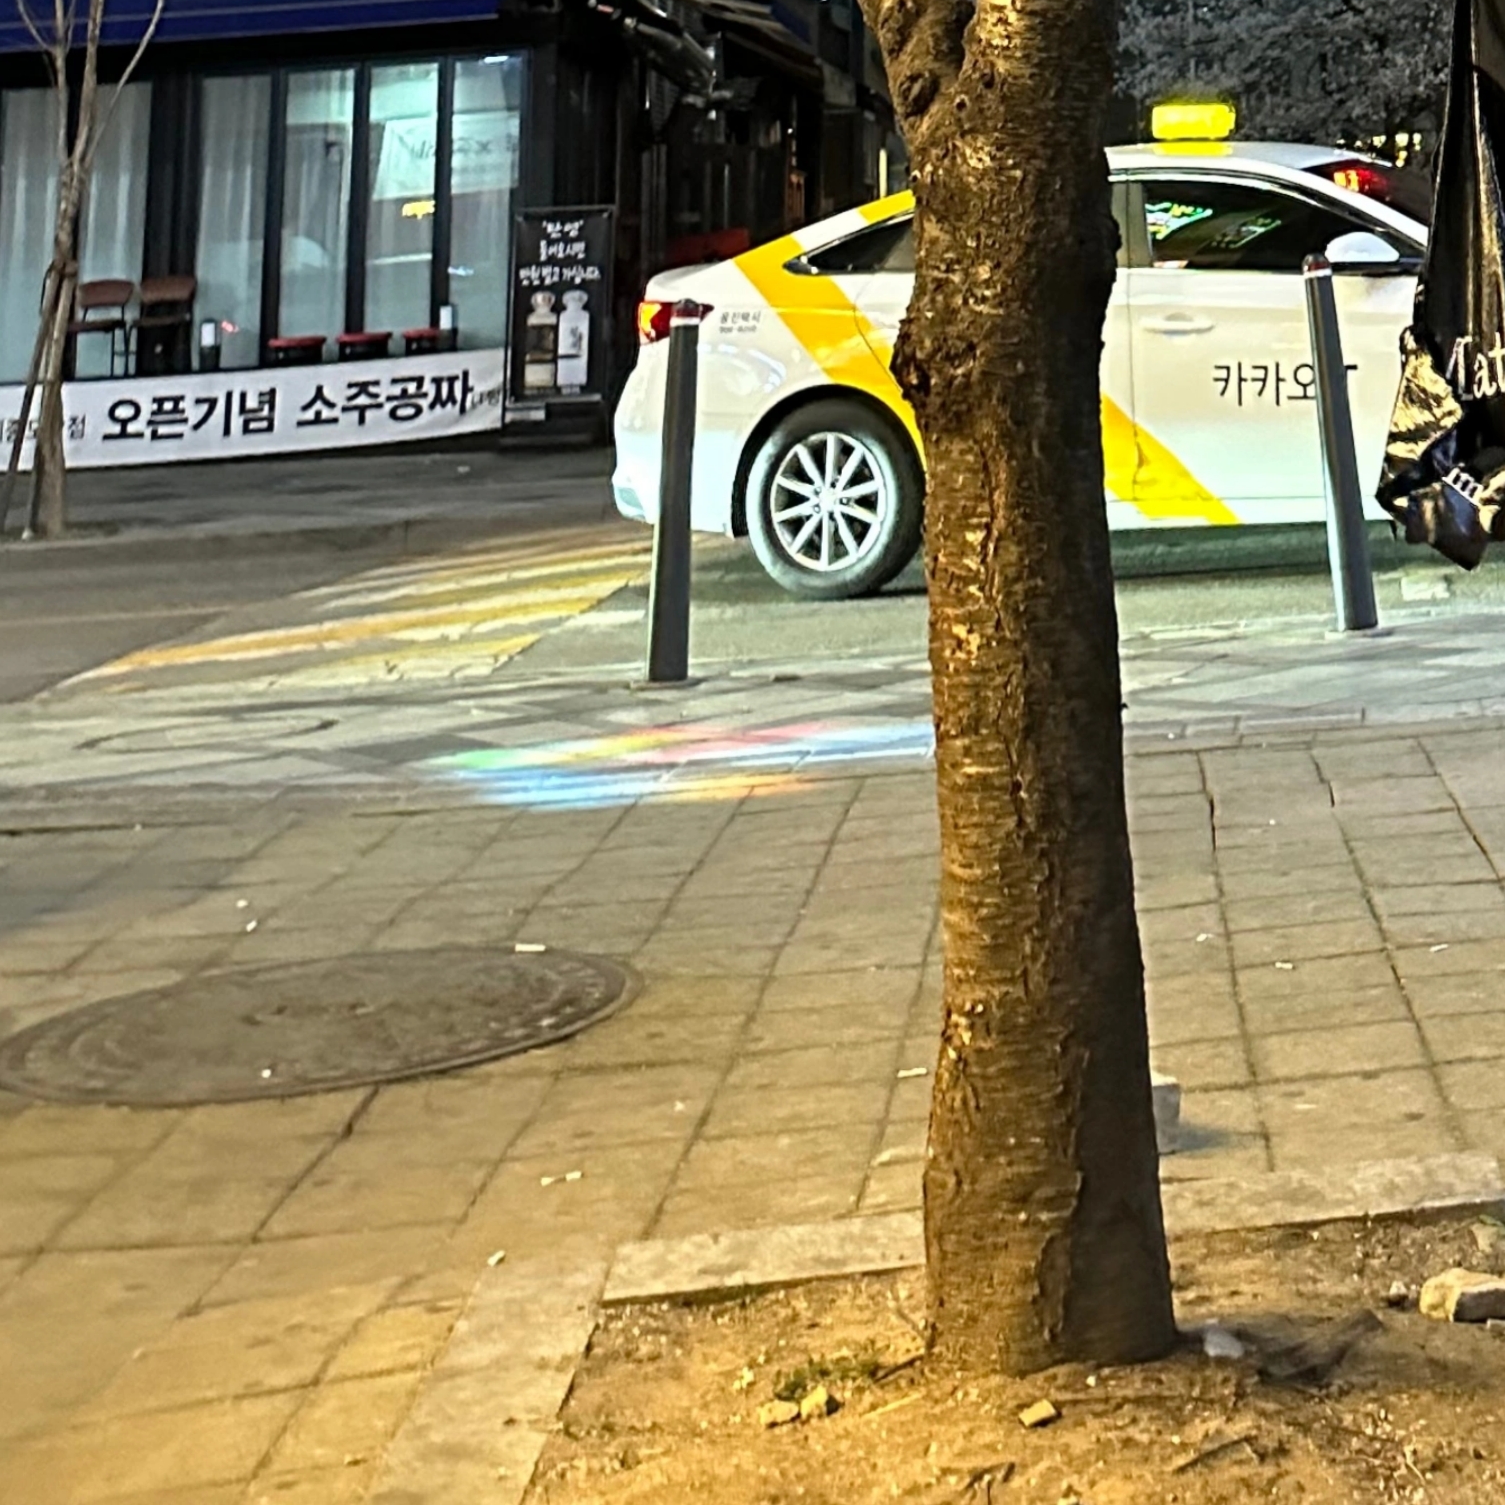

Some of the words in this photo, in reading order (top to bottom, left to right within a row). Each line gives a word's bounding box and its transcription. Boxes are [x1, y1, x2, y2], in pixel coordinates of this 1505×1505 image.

[101, 387, 277, 442] 오픈기념
[296, 369, 475, 428] 소주공짜
[1212, 361, 1317, 407] 카카오
